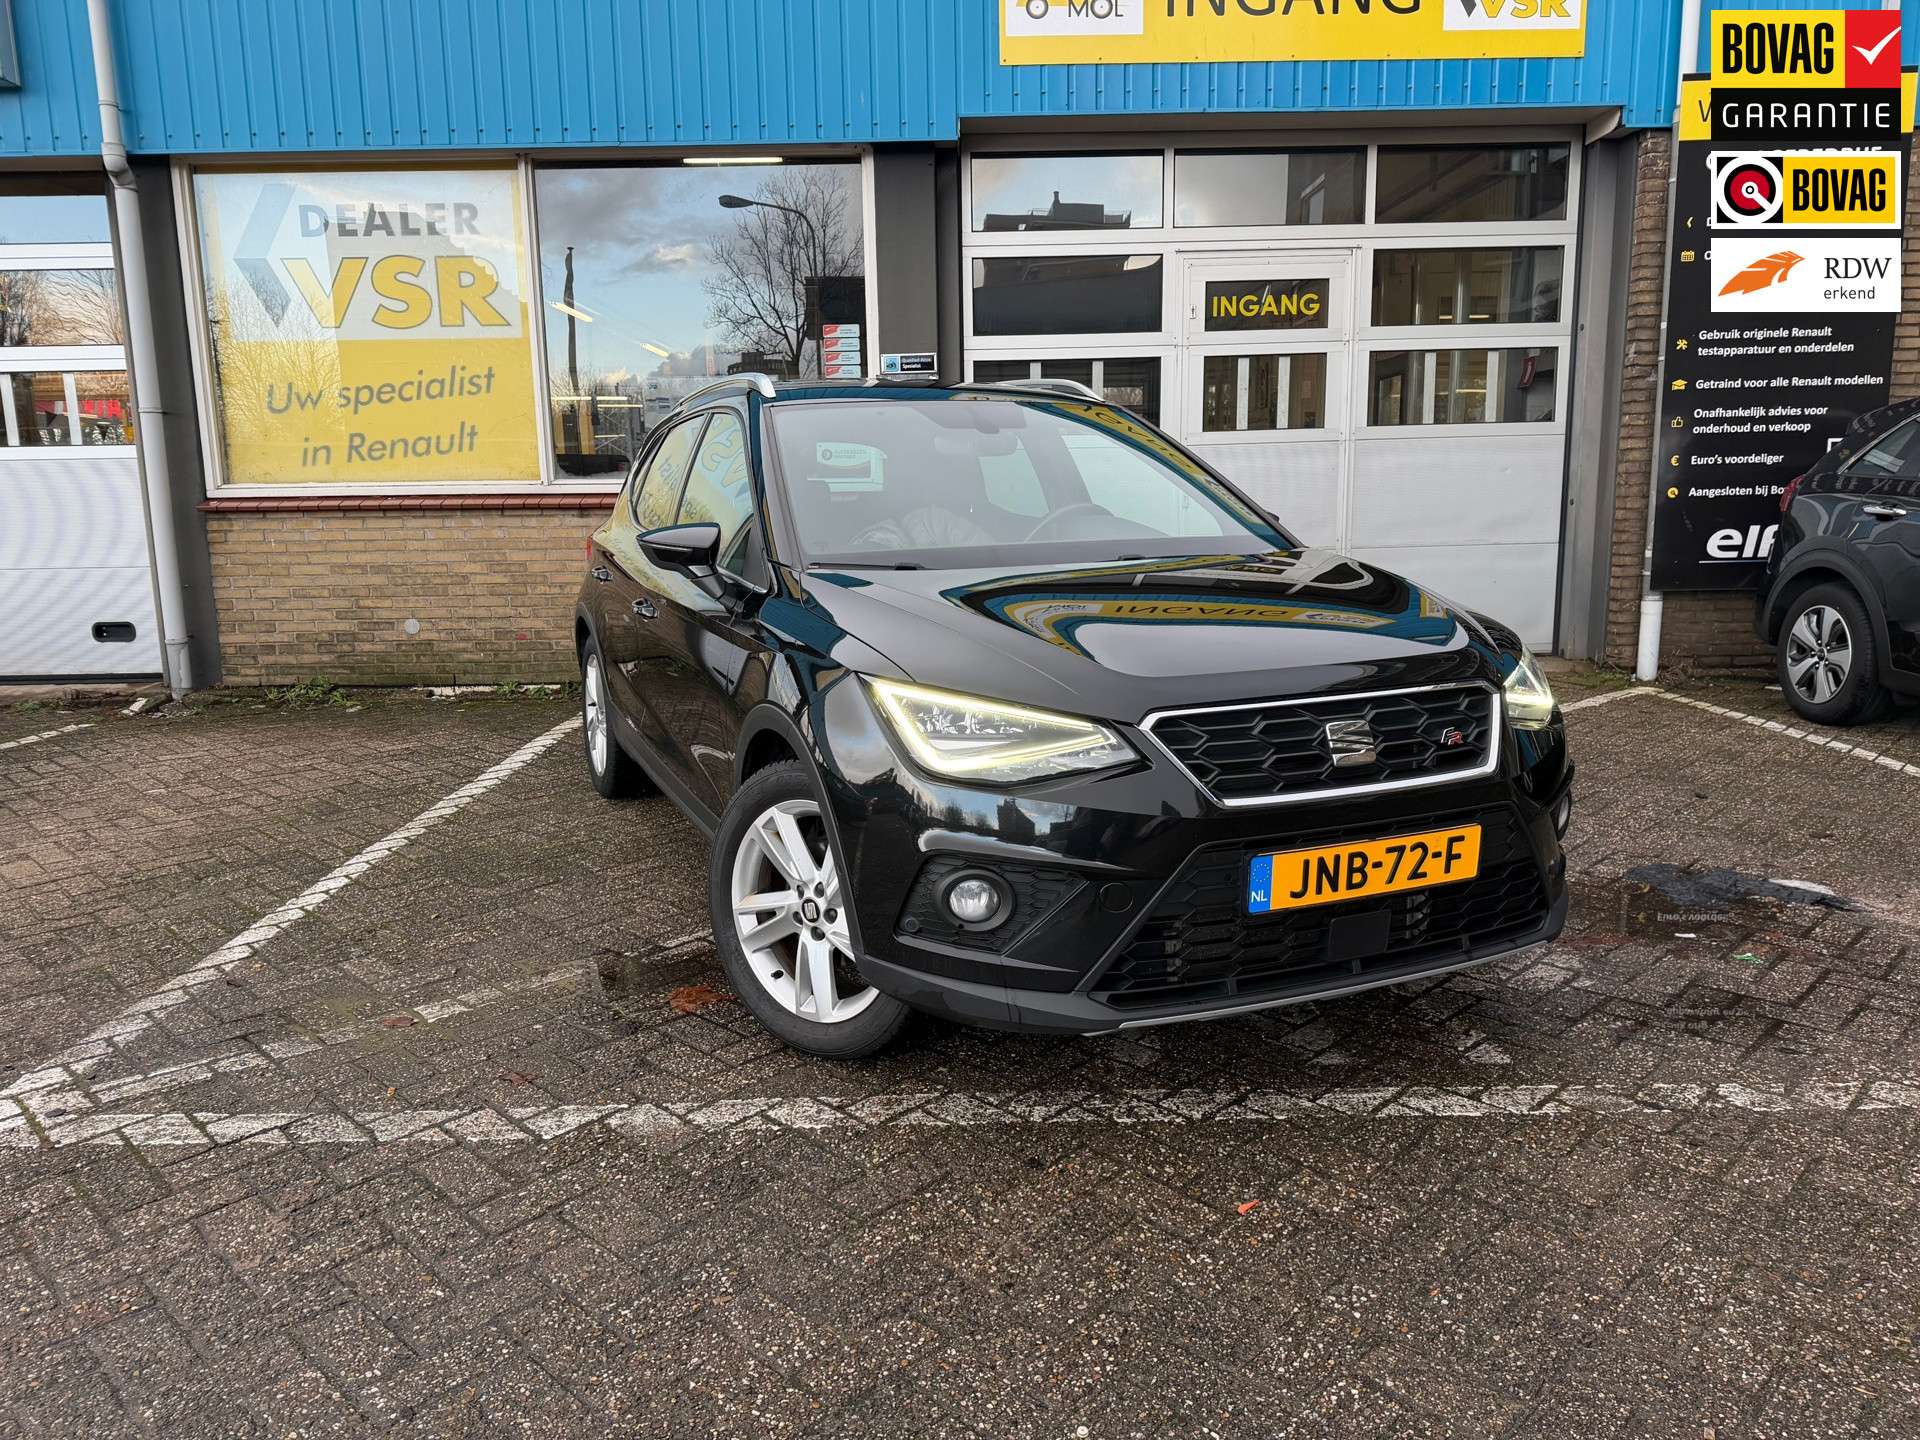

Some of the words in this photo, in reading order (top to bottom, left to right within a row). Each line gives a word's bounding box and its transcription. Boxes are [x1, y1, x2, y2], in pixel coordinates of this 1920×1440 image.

[299, 201, 480, 238] DEALER
[281, 255, 511, 330] VSR
[1212, 293, 1321, 317] INGANG
[1699, 329, 1741, 340] Gebruik
[1743, 328, 1789, 341] originele
[1791, 326, 1832, 338] Renault
[1698, 345, 1776, 357] testapparatuur
[1778, 344, 1792, 353] en
[1794, 342, 1854, 353] onderdelen
[1695, 378, 1742, 390] Getraind
[1744, 379, 1768, 388] voor
[1770, 377, 1789, 387] alle
[1791, 376, 1832, 387] Renault
[1834, 375, 1884, 386] modellen
[266, 383, 323, 415] Uw
[338, 366, 495, 415] specialist
[1694, 407, 1766, 419] Onafhankelijk
[1768, 406, 1802, 416] advies
[1804, 406, 1828, 415] voor
[1693, 423, 1750, 434] onderhoud
[1753, 424, 1766, 433] en
[1768, 422, 1811, 433] verkoop
[302, 434, 331, 467] in
[347, 422, 479, 463] Renault
[1724, 453, 1784, 465] voordeliger
[1689, 486, 1753, 498] Aangesloten
[1755, 485, 1768, 497] bij
[1706, 524, 1779, 559] elf
[1290, 835, 1465, 899] JNB-72-F
[1251, 889, 1268, 904] NL
